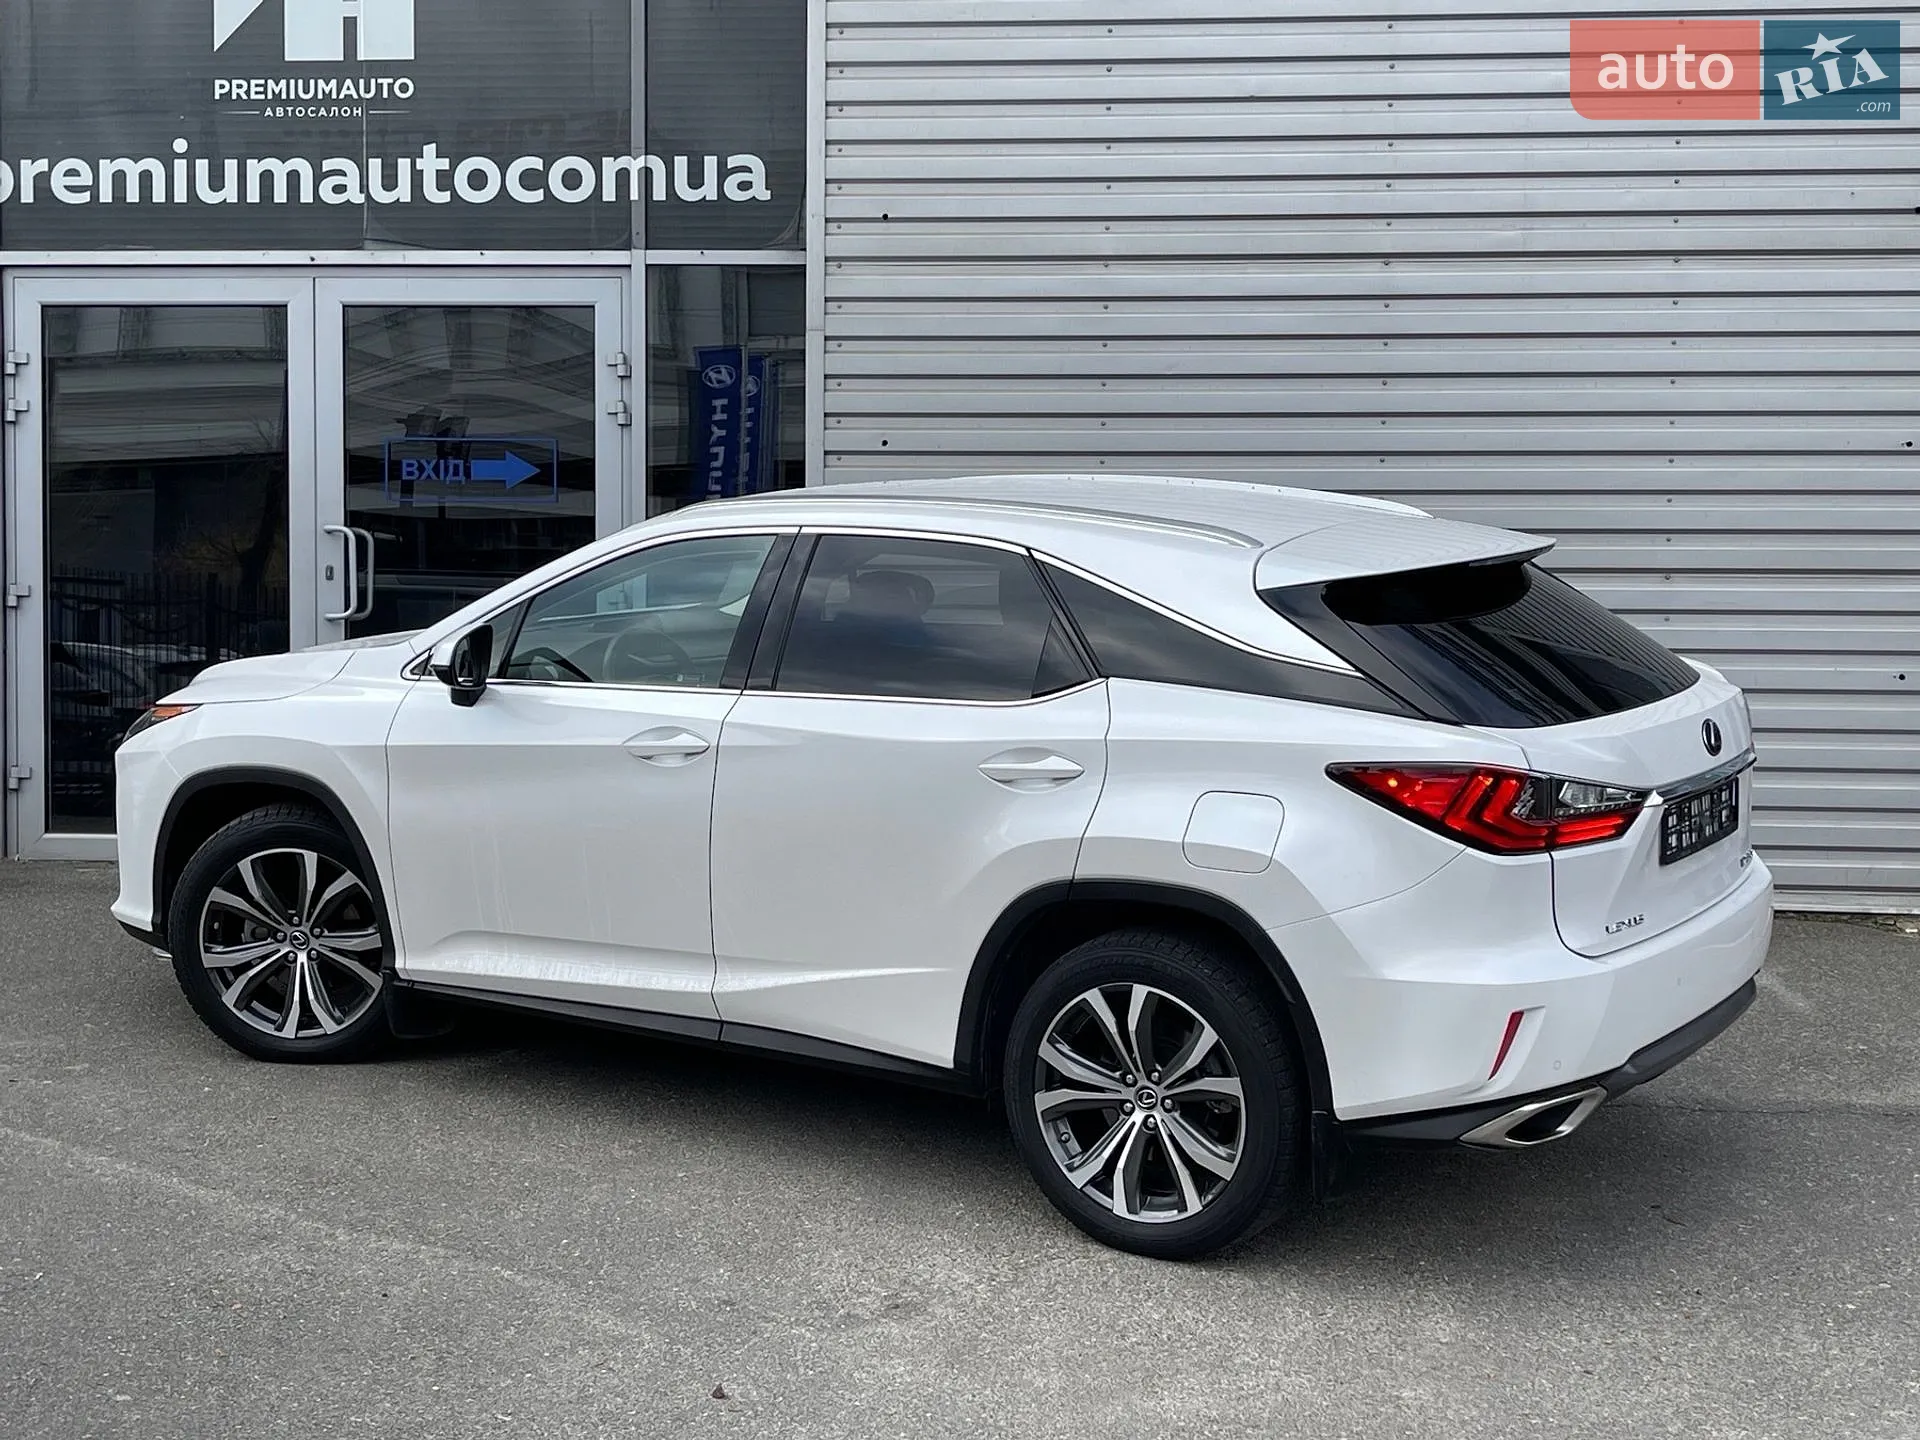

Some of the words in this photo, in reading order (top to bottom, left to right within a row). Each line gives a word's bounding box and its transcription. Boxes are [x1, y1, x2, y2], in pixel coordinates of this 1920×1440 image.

[213, 78, 415, 101] PREMIUMAUTO
[263, 106, 363, 118] АВТОСАЛОН
[401, 458, 467, 485] ВХІД
